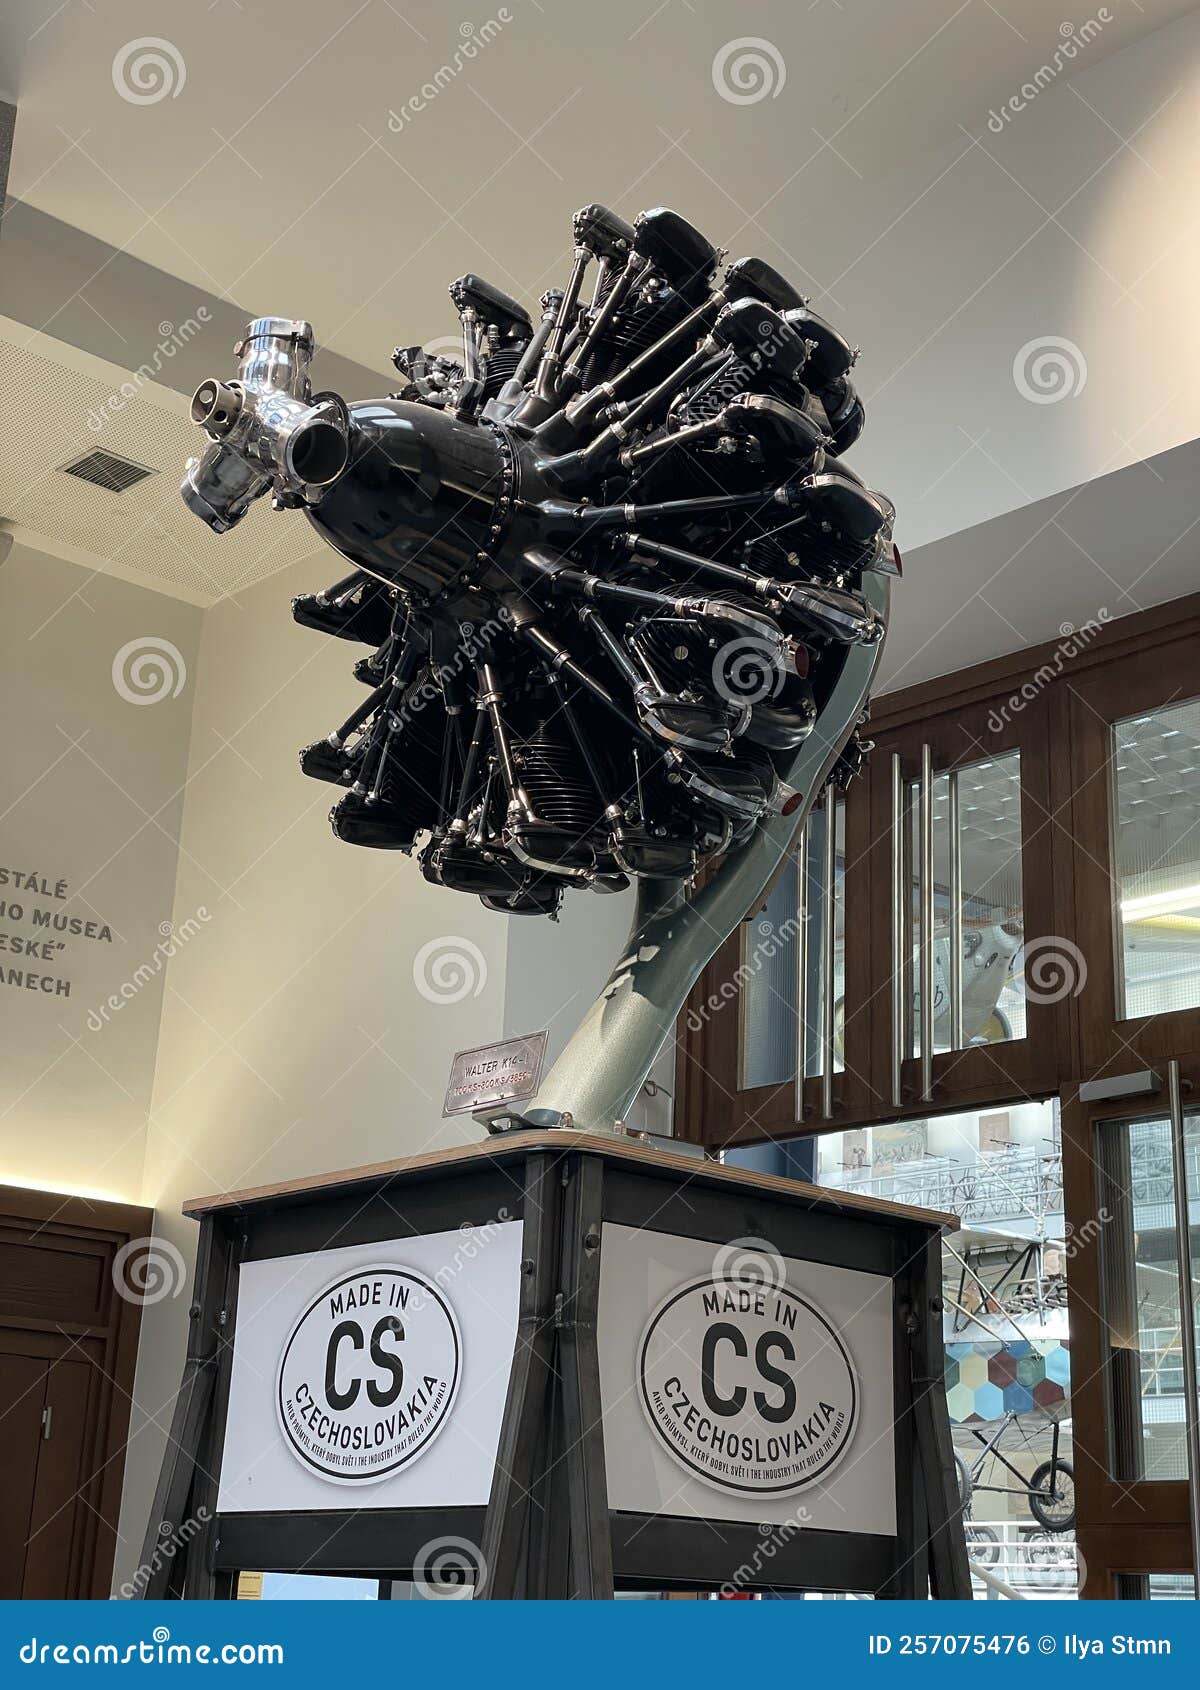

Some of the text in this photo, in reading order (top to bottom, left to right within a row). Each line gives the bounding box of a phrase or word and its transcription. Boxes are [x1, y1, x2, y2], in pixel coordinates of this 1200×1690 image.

[0, 868, 68, 900] STÁLÉ
[32, 908, 112, 943] MUSEA
[465, 1060, 498, 1078] WALTER
[330, 1282, 410, 1320] MADE IN
[702, 1289, 798, 1331] MADE IN
[325, 1315, 406, 1411] CS
[701, 1322, 797, 1424] CS
[295, 1376, 438, 1450] CZECHOSLOVAKIA
[407, 1423, 425, 1445] RULED
[423, 1410, 434, 1426] THE
[432, 1381, 447, 1413] WORLD
[664, 1376, 835, 1463] CZECHOSLOVAKIA
[690, 1444, 710, 1464] KTERÝ
[710, 1457, 729, 1474] DOBYL
[751, 1468, 761, 1479] THE
[763, 1465, 791, 1480] INDUSTRY
[791, 1460, 807, 1474] THAT
[806, 1447, 824, 1467] RULED
[823, 1437, 834, 1453] THE
[830, 1411, 845, 1440] WORLD
